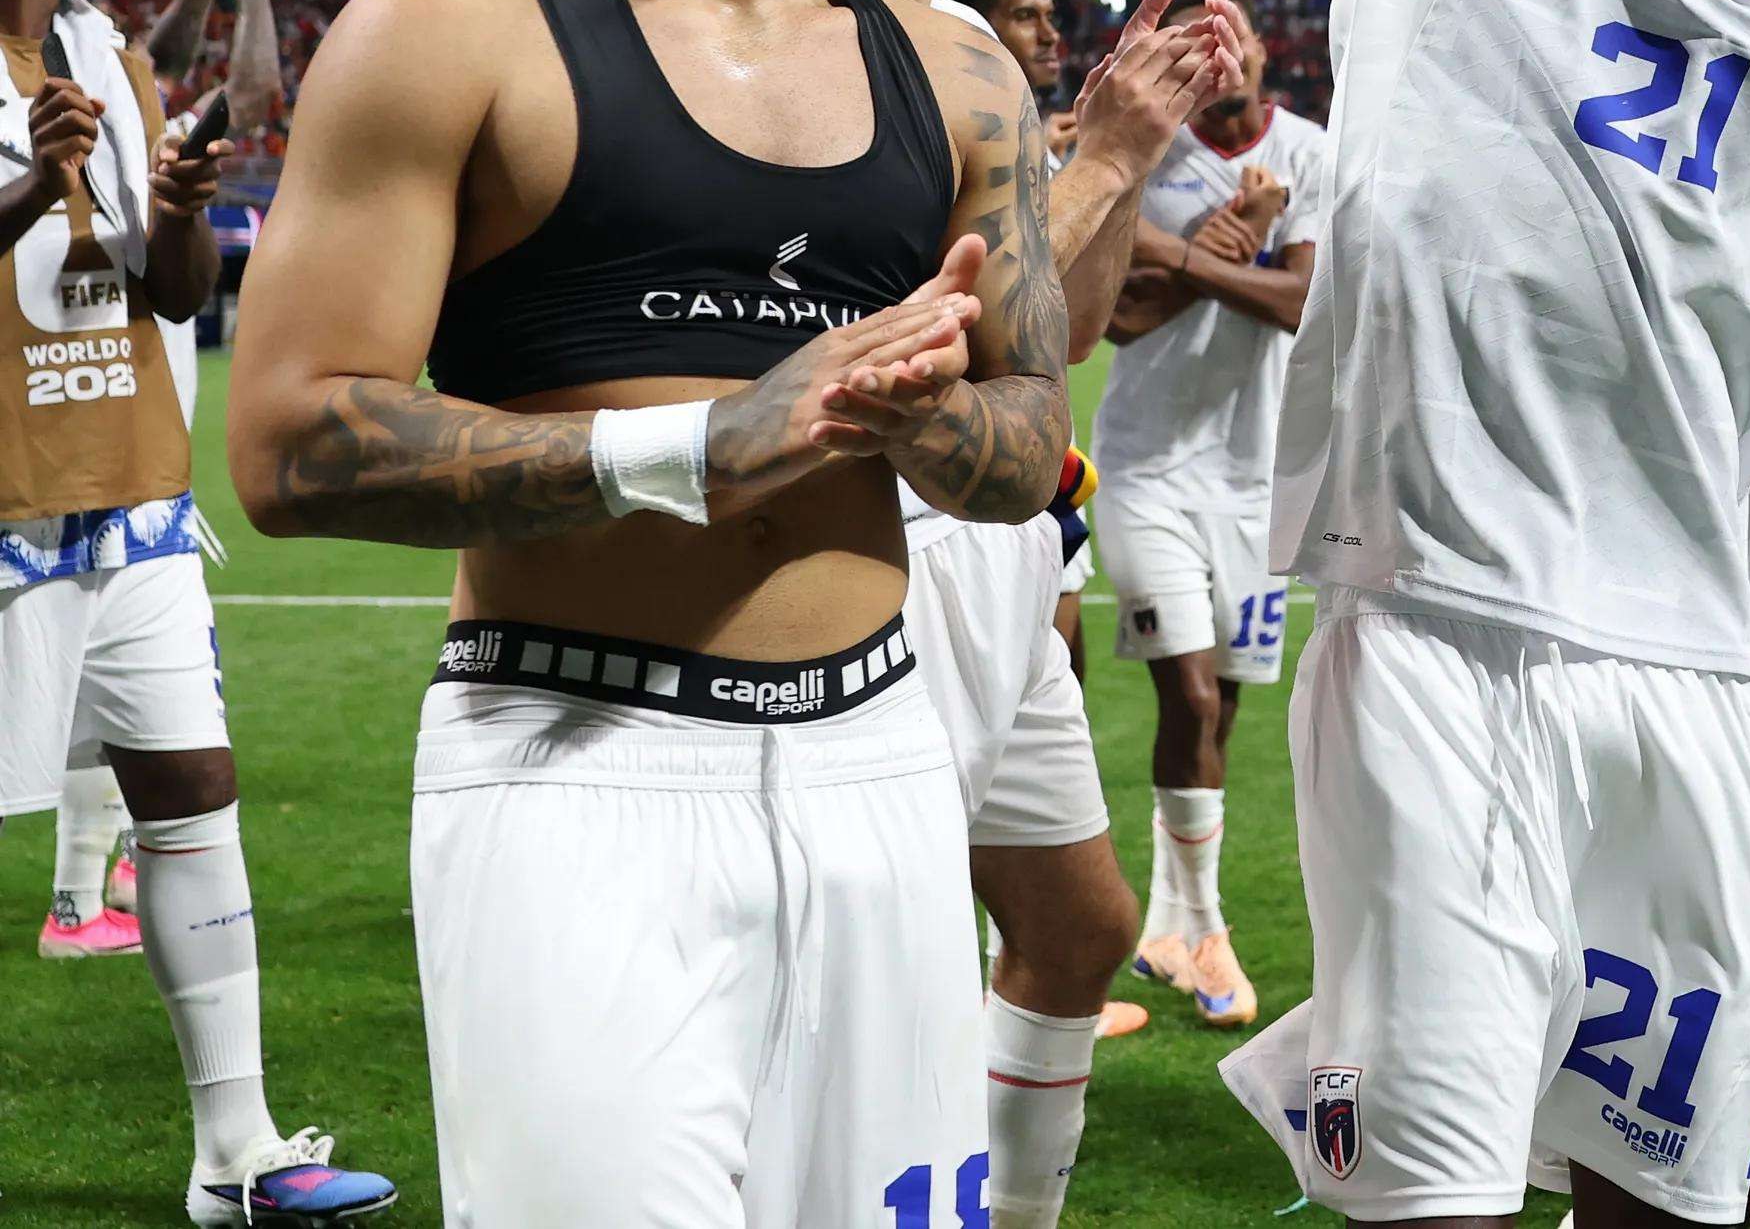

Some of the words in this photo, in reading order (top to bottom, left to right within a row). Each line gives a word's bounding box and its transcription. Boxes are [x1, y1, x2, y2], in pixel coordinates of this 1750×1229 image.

[61, 281, 122, 308] FIFA
[639, 290, 861, 331] CATAPU
[23, 338, 119, 367] WORLD
[1229, 590, 1286, 648] 15
[439, 630, 503, 670] apelli
[450, 661, 497, 672] SPORT
[710, 668, 825, 712] capelli
[766, 699, 825, 716] SPORT
[1560, 948, 1722, 1128] 21
[1314, 1073, 1355, 1091] FCF
[1601, 1103, 1688, 1160] capelli
[1630, 1142, 1679, 1168] SPORT
